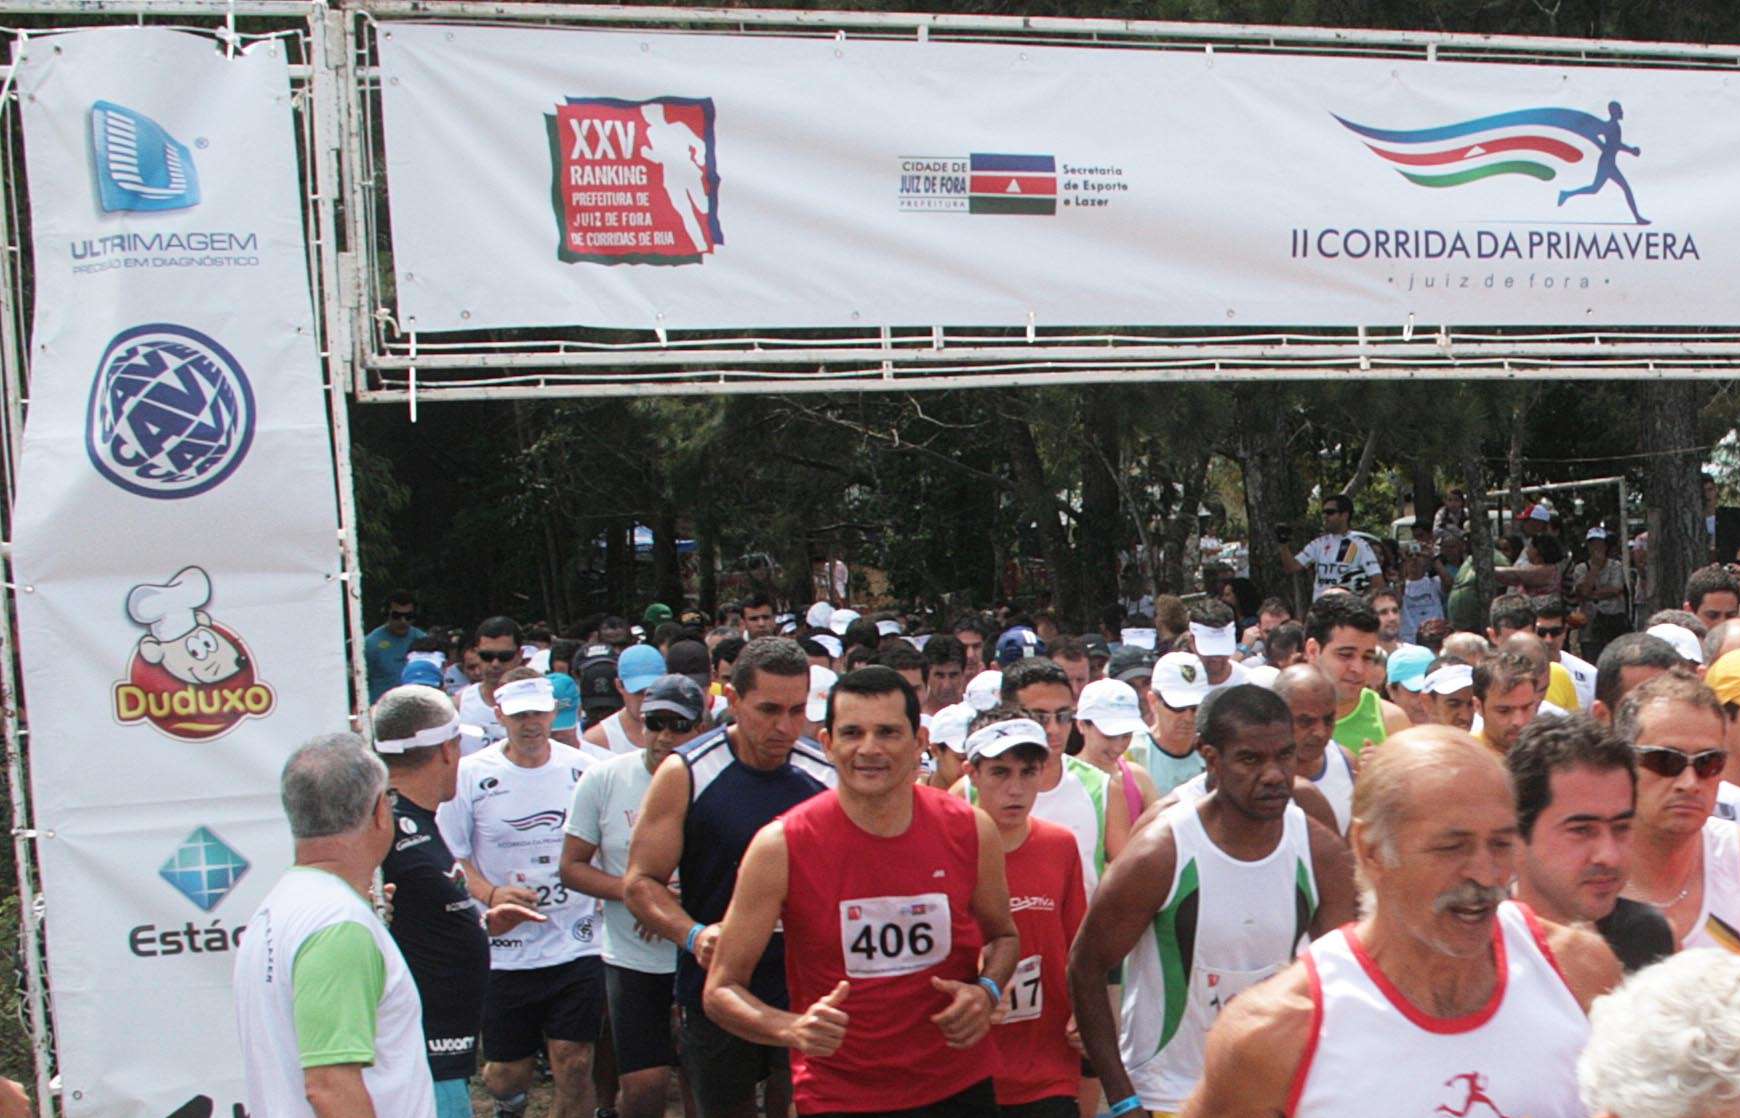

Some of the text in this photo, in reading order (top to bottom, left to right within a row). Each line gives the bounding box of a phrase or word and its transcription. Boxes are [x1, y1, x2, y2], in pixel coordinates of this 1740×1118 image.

[569, 118, 635, 160] XXV
[570, 164, 648, 186] RANKING
[902, 161, 967, 173] CIDADE DE
[1062, 164, 1123, 176] Secretaria
[900, 175, 967, 194] JUIZ DE FORA
[1063, 180, 1128, 194] de Esporte
[572, 191, 649, 207] PREFEITURA DE
[900, 200, 966, 209] PREFEITURA
[1063, 196, 1109, 207] e Lazer
[573, 212, 653, 227] JUIZ DE FORA
[70, 232, 258, 260] ULTRIMAGEM
[571, 231, 675, 247] DE CORRIDAS DE RUA
[1291, 228, 1701, 261] II CORRIDA DA PRIMAVERA
[123, 258, 149, 268] EM
[152, 255, 260, 267] DIAGNÓSTICO
[1409, 273, 1590, 291] juiz de fora
[117, 684, 272, 720] Duduxo
[526, 882, 570, 907] 23
[850, 922, 934, 960] 406
